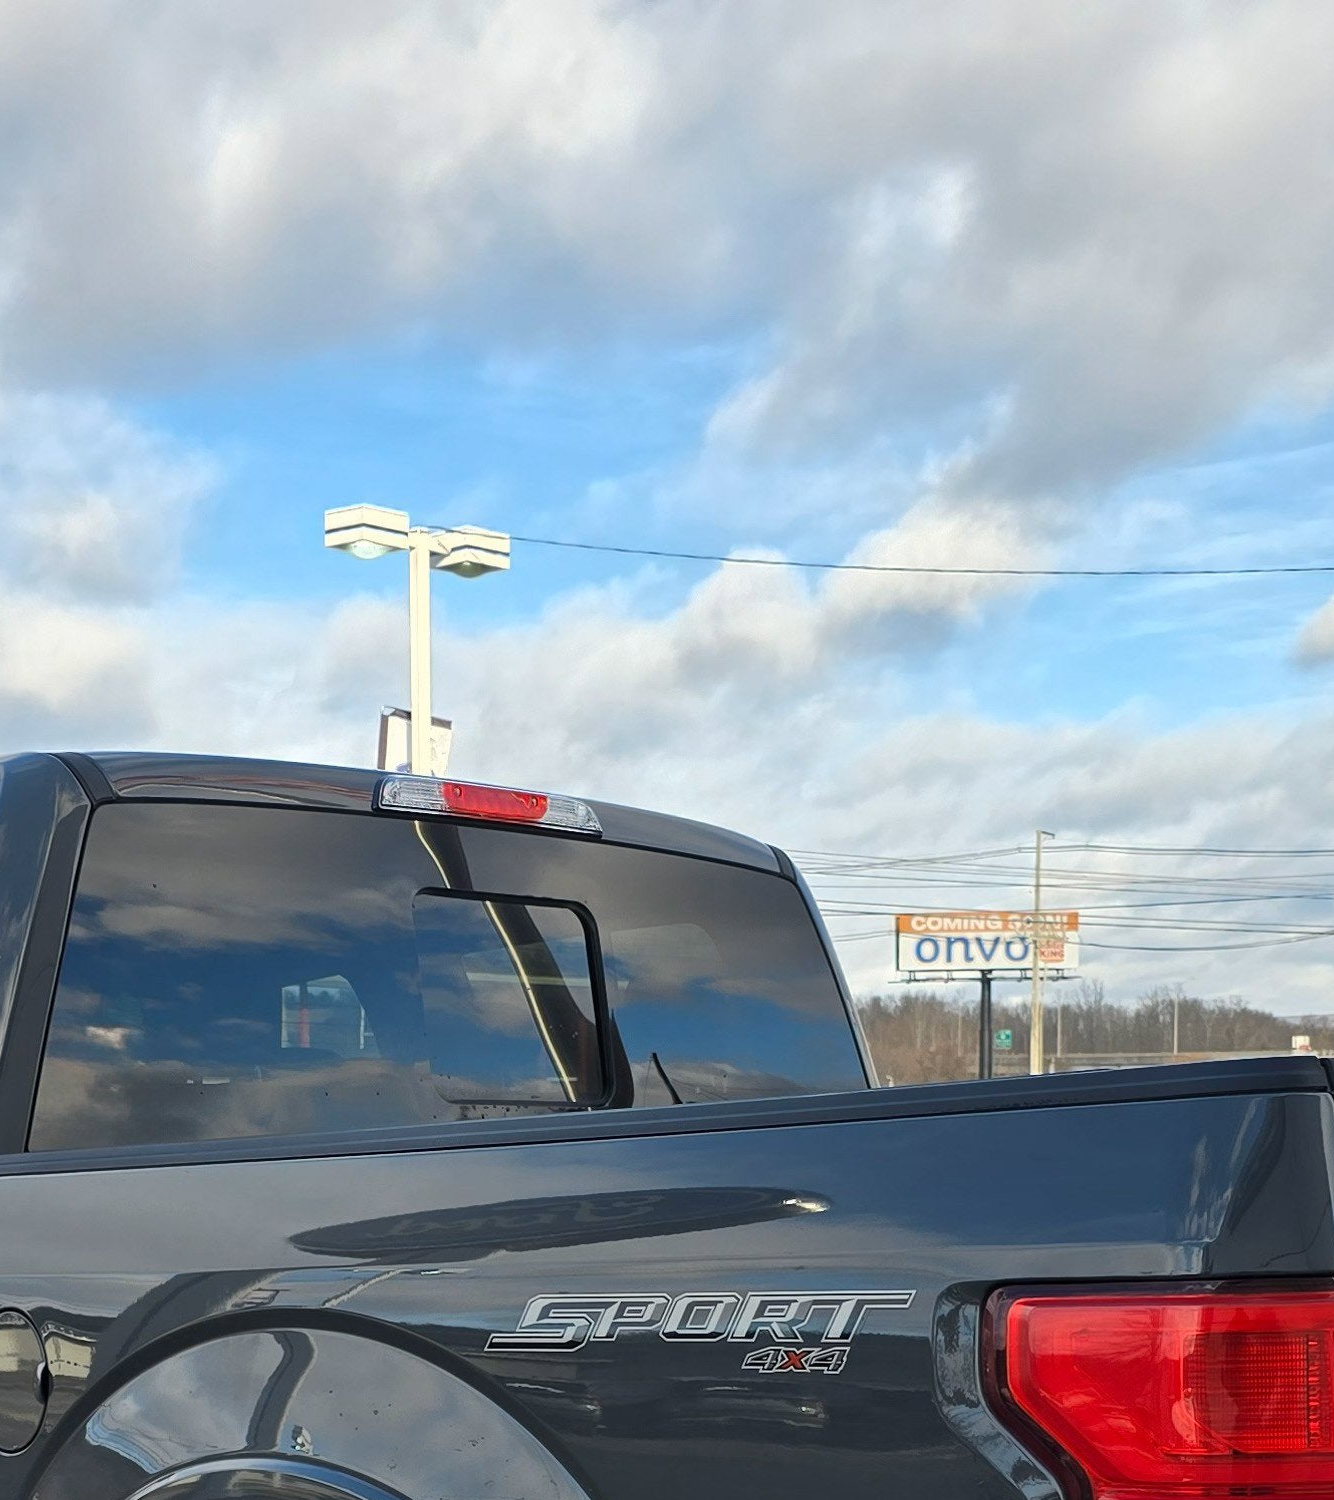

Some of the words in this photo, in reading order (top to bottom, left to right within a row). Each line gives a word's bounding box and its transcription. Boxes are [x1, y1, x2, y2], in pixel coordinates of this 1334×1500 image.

[910, 915, 1002, 931] COMING
[915, 936, 1029, 963] onvo
[484, 1290, 917, 1352] SPORT
